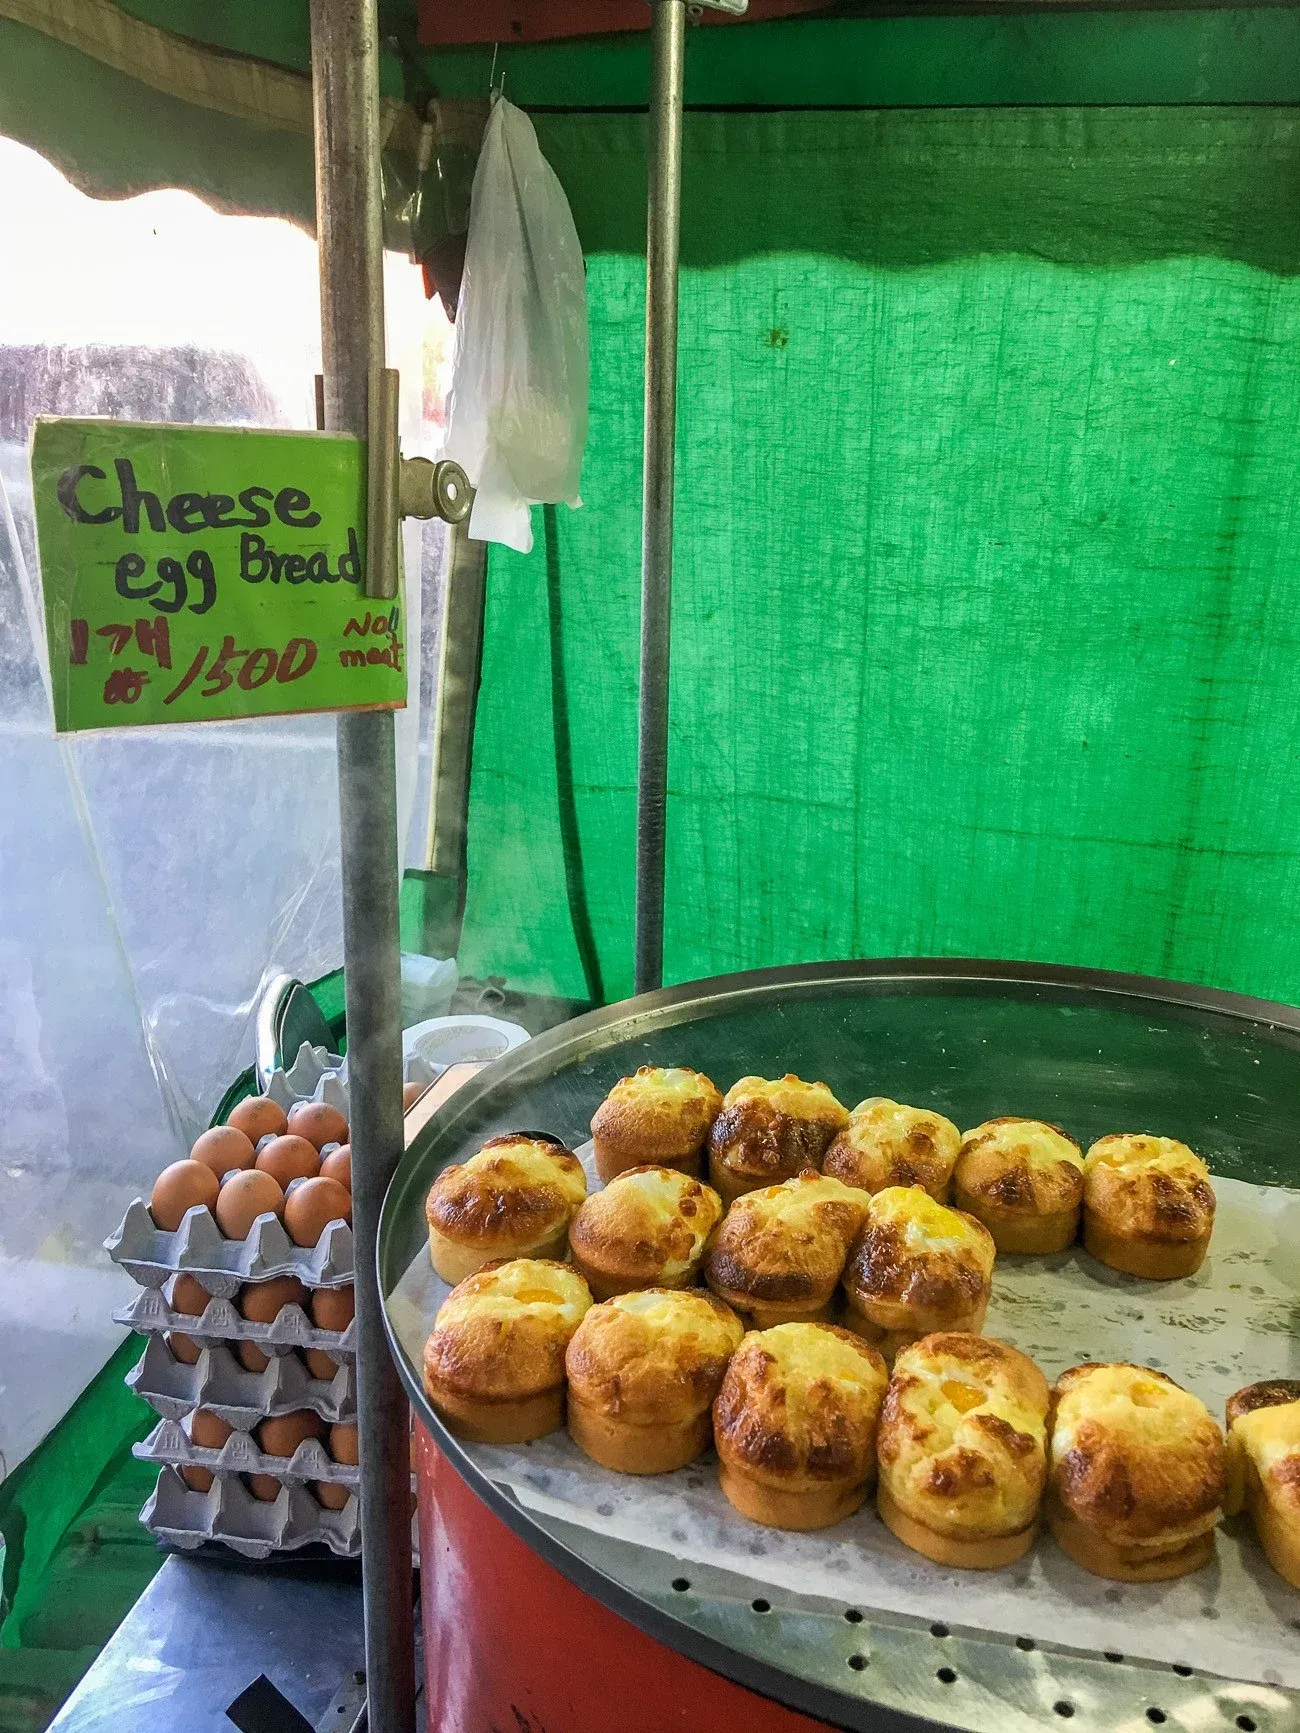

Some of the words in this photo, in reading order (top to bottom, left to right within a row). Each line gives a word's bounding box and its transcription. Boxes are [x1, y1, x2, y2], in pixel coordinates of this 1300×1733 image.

[57, 458, 322, 534] Cheese
[115, 550, 218, 615] egg
[240, 527, 363, 585] Bread
